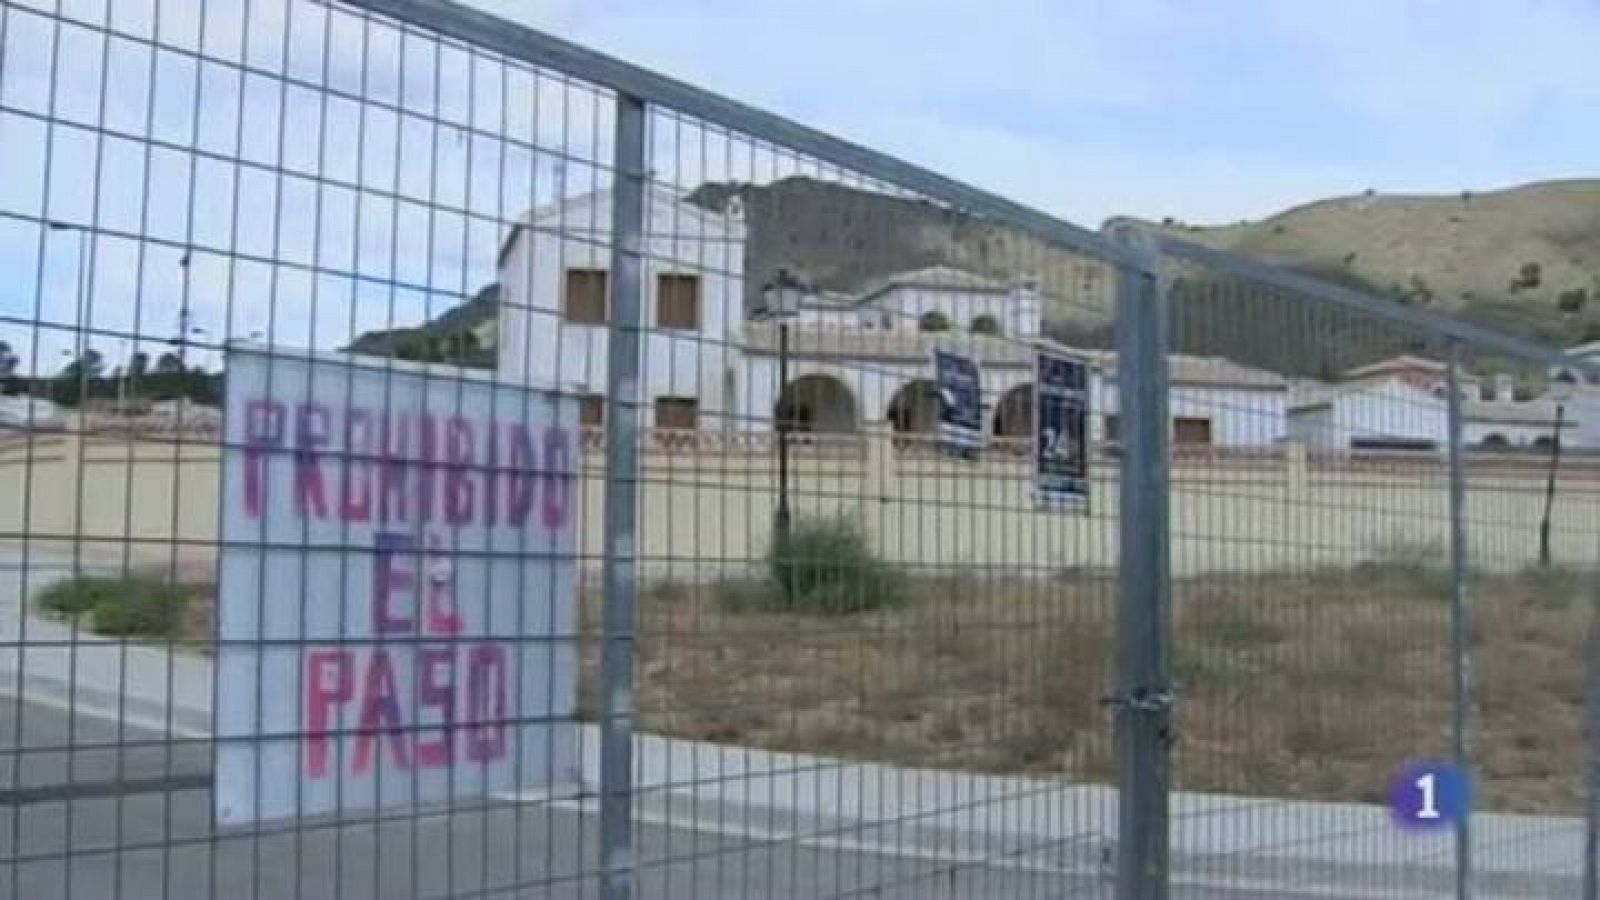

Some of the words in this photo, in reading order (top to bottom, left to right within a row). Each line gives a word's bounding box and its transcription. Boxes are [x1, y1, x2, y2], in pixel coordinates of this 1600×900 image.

[243, 399, 572, 530] PROHIBIDO
[373, 531, 465, 634] EL
[305, 644, 508, 779] PASO
